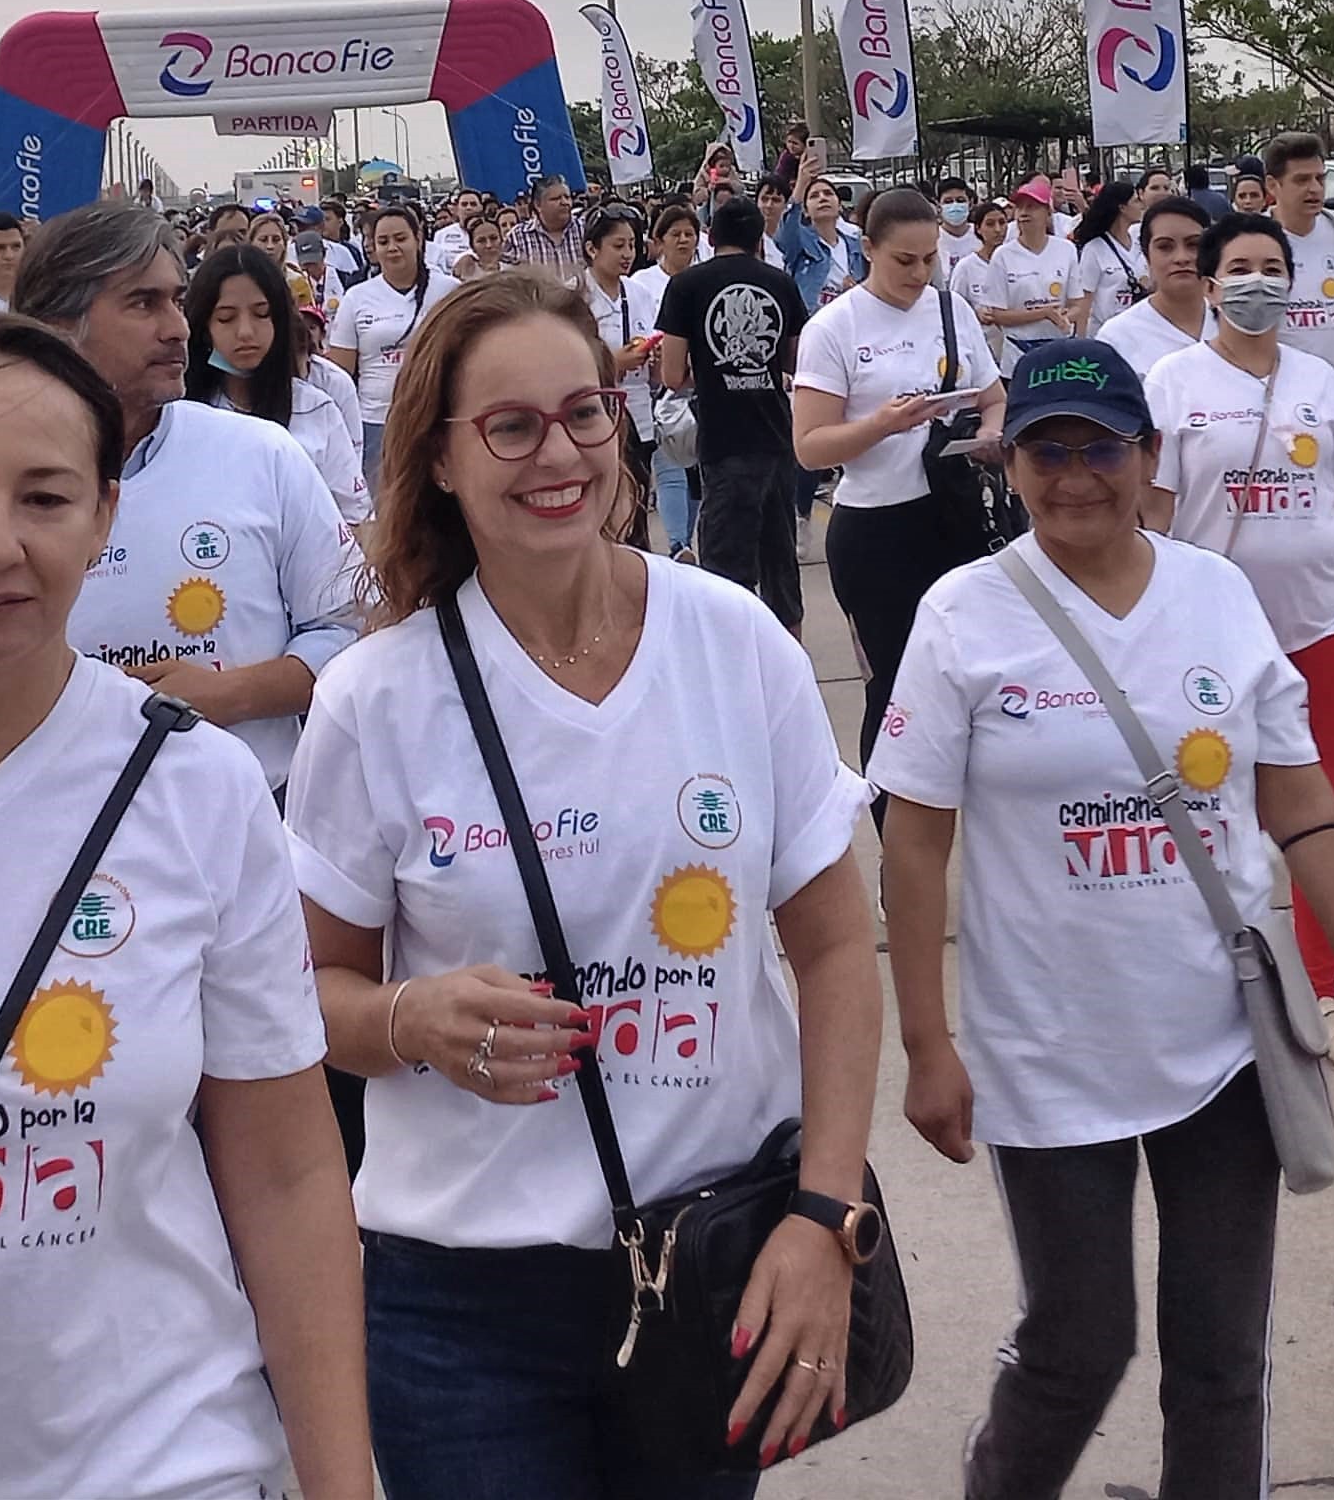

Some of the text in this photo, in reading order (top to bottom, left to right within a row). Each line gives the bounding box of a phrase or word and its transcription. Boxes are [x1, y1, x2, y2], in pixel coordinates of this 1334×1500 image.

[232, 116, 318, 132] PARTIDA
[175, 645, 200, 660] por
[699, 812, 731, 833] CRE
[72, 918, 115, 940] CRE
[654, 965, 692, 993] por
[697, 964, 716, 988] la
[624, 1073, 641, 1085] EL
[20, 1106, 67, 1139] por
[74, 1099, 96, 1125] la
